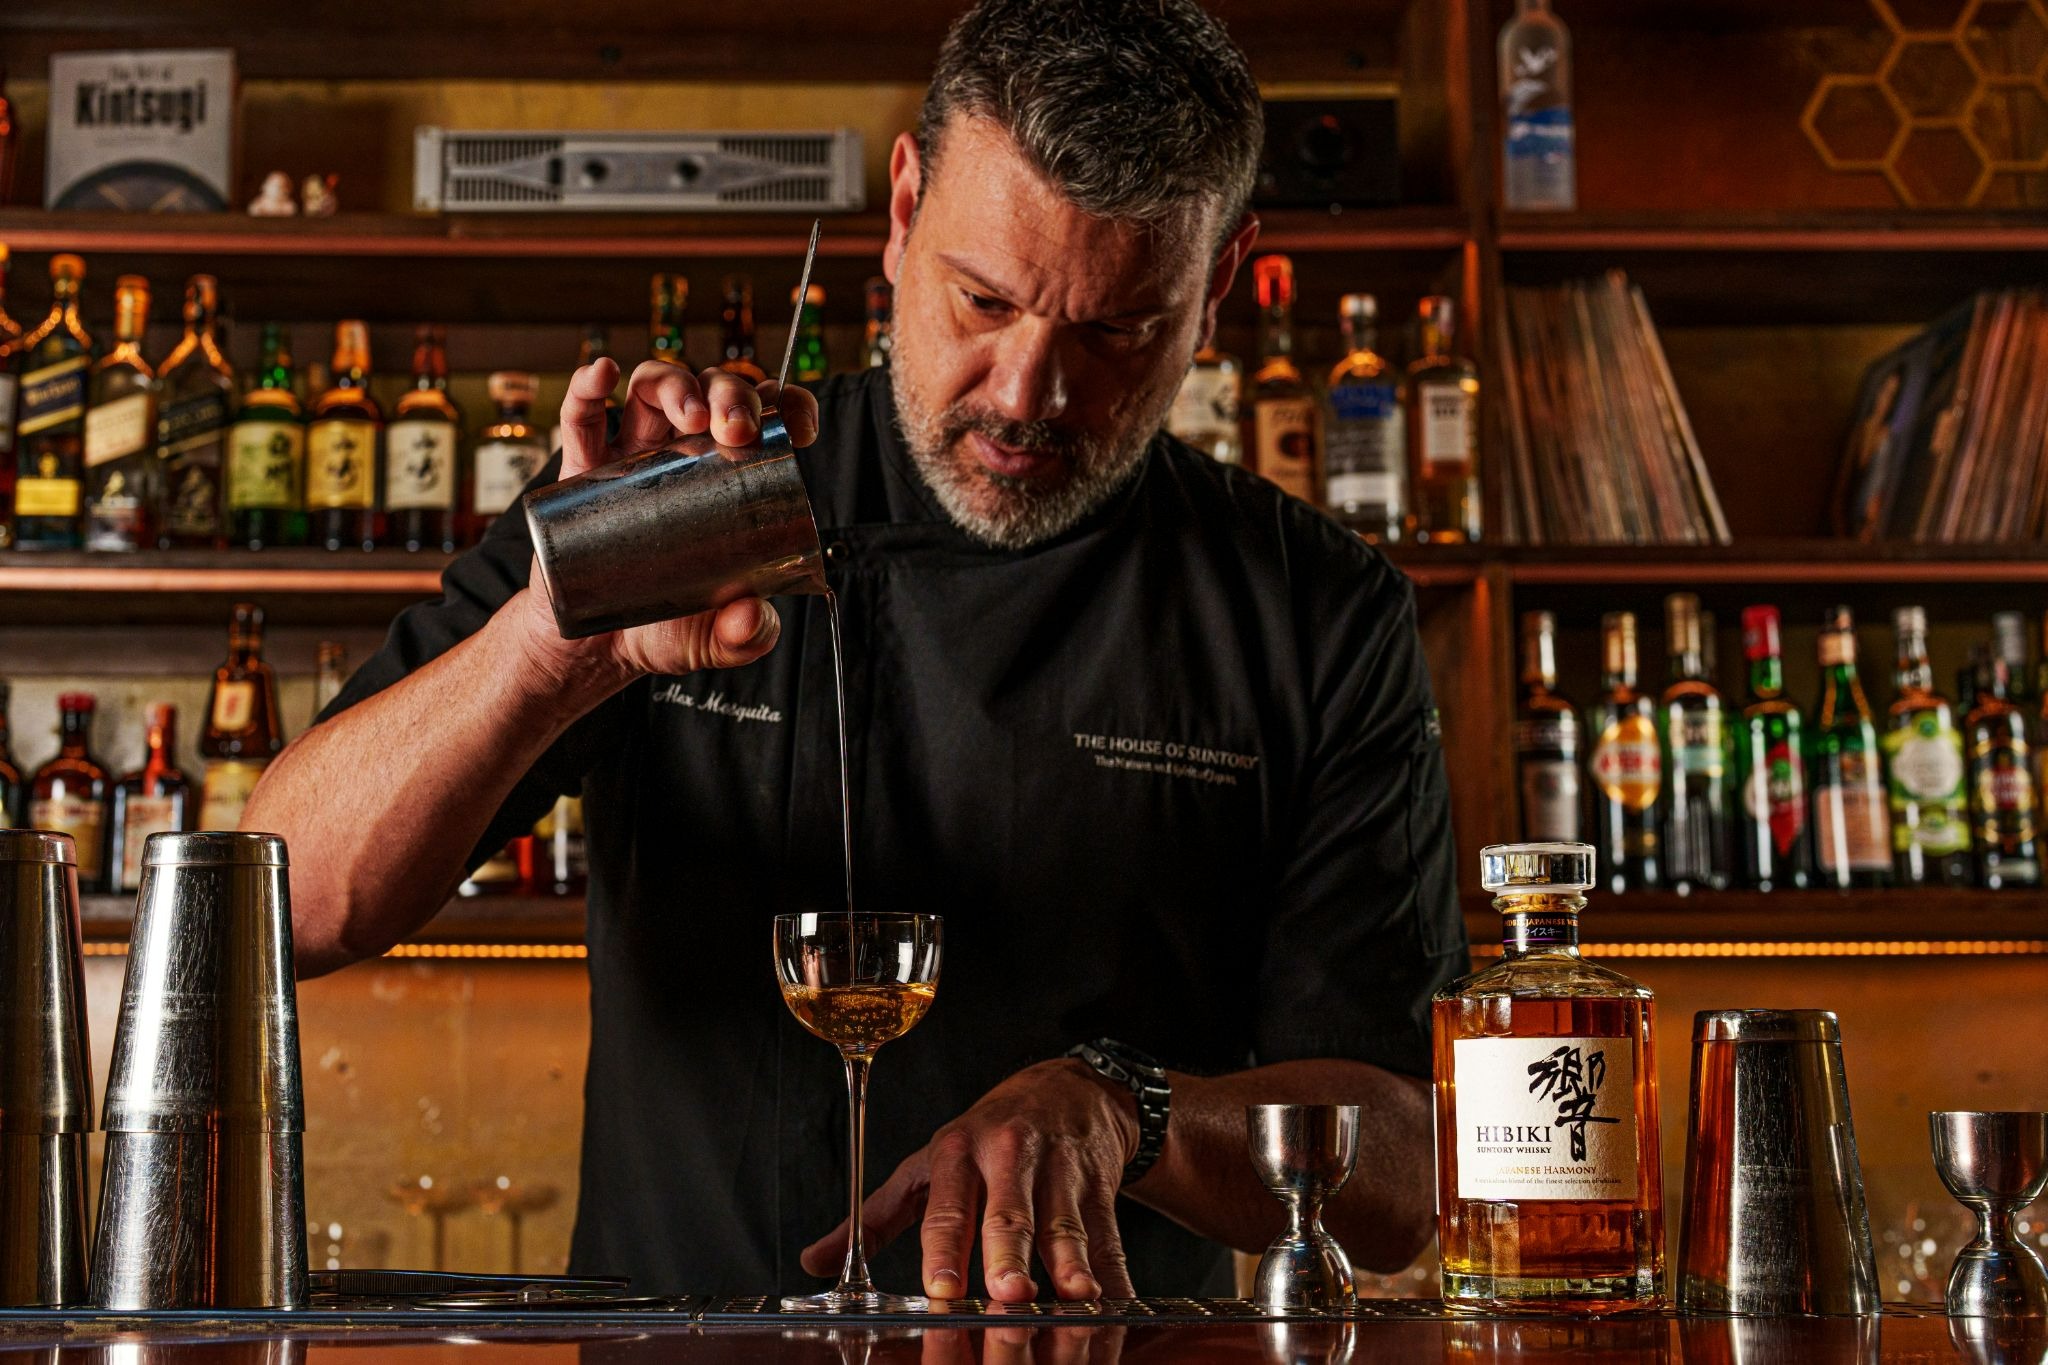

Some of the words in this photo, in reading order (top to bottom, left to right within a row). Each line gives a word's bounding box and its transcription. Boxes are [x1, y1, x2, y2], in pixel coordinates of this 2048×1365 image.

[76, 80, 206, 134] Kintsugi
[652, 683, 694, 707] Alex
[1073, 733, 1106, 750] THE
[1109, 737, 1162, 755] HOUSE
[1165, 743, 1186, 758] OF
[1187, 746, 1259, 770] SUNTORY
[1526, 918, 1565, 927] JAPANESE
[1528, 1046, 1621, 1161] 響
[1476, 1126, 1552, 1143] HIBIKI
[1477, 1146, 1513, 1154] SUNTORY
[1516, 1146, 1552, 1154] WHISKY
[1544, 1165, 1597, 1175] HARMONY
